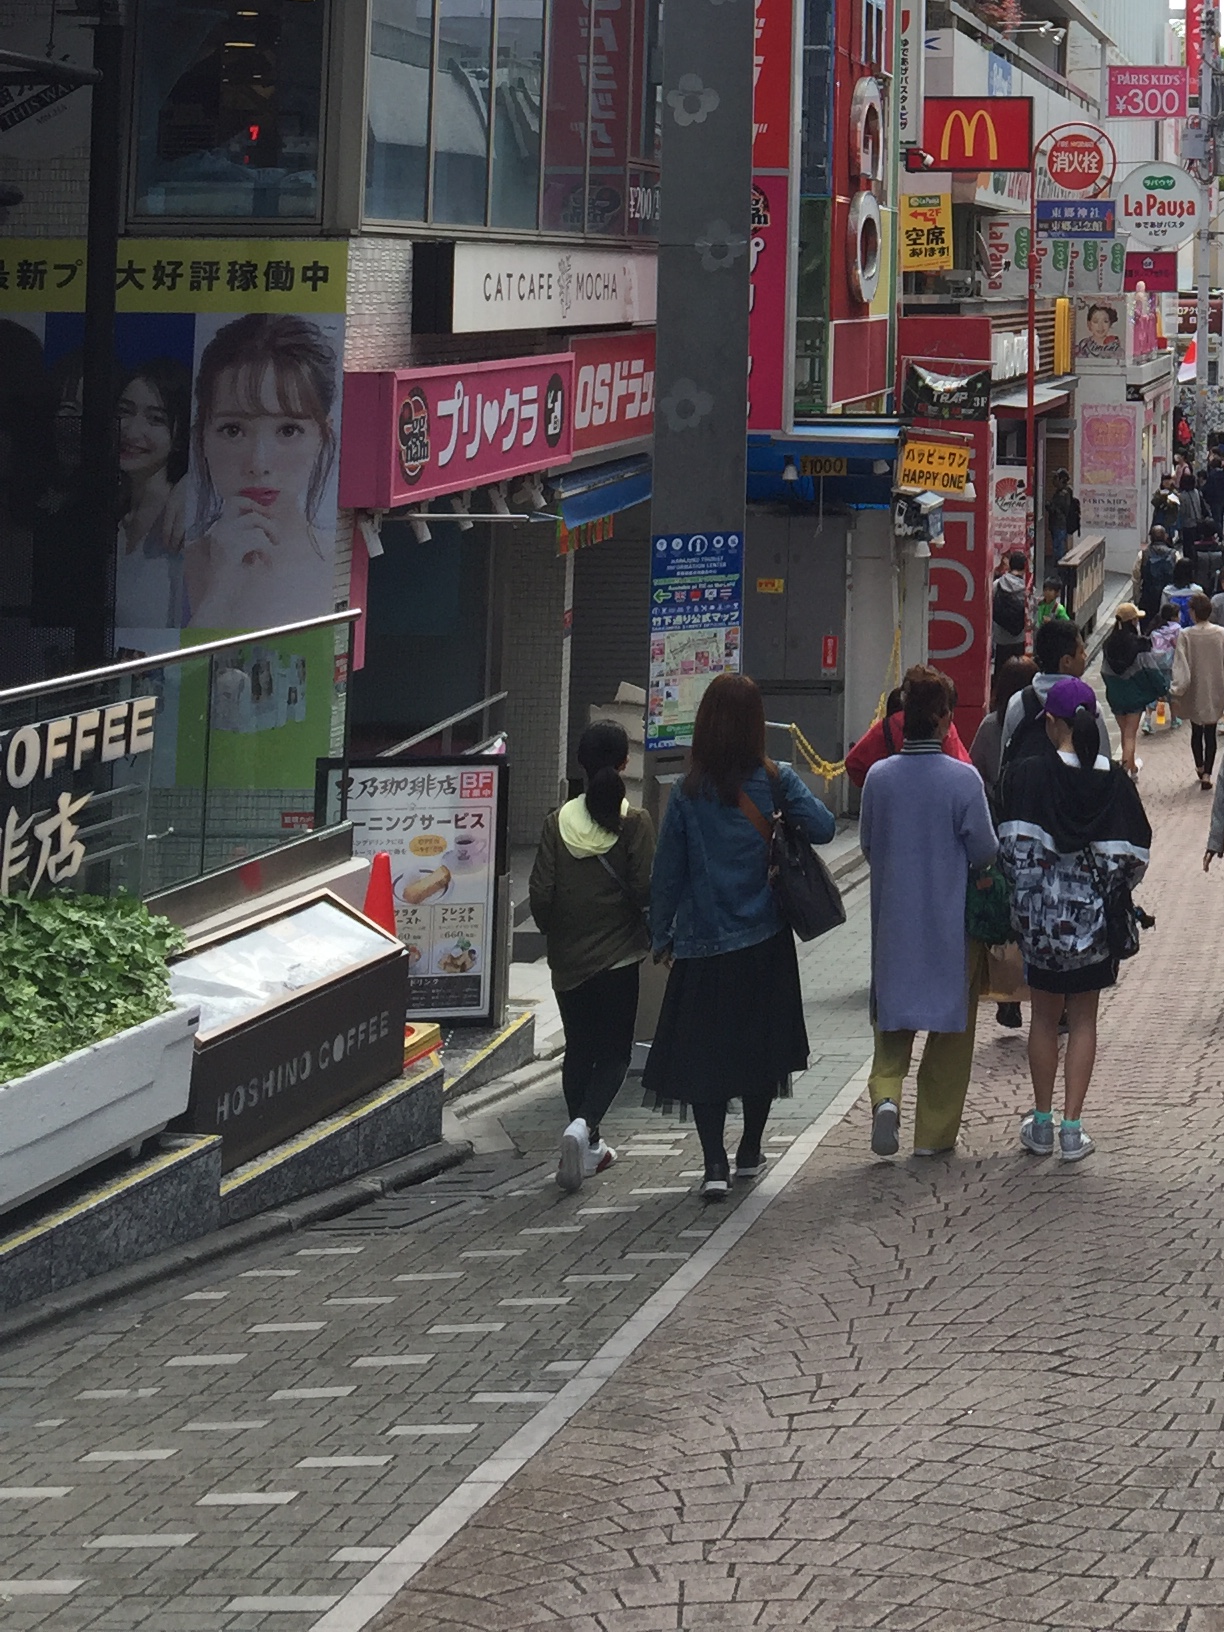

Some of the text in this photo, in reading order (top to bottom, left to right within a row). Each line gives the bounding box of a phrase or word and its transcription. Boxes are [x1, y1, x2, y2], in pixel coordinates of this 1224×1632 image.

[1116, 71, 1182, 86] PARIS KID'S
[1115, 88, 1180, 114] ¥300
[1052, 150, 1100, 174] 消火栓
[927, 208, 942, 217] 2F
[1123, 193, 1196, 219] La Pausa
[905, 226, 946, 246] 空席
[909, 246, 950, 258] あります!
[115, 259, 330, 293] 大好評稼働中
[483, 272, 618, 301] CAT CAFE MOCHA
[931, 391, 988, 408] TRAP 3F
[906, 448, 968, 468] ハッピーワン
[902, 468, 965, 491] HAPPY ONE
[0, 696, 157, 789] OFFEE
[462, 771, 493, 788] BF
[352, 812, 486, 832] ーニングサービス
[215, 1009, 390, 1126] HOSHINO COFFEE
